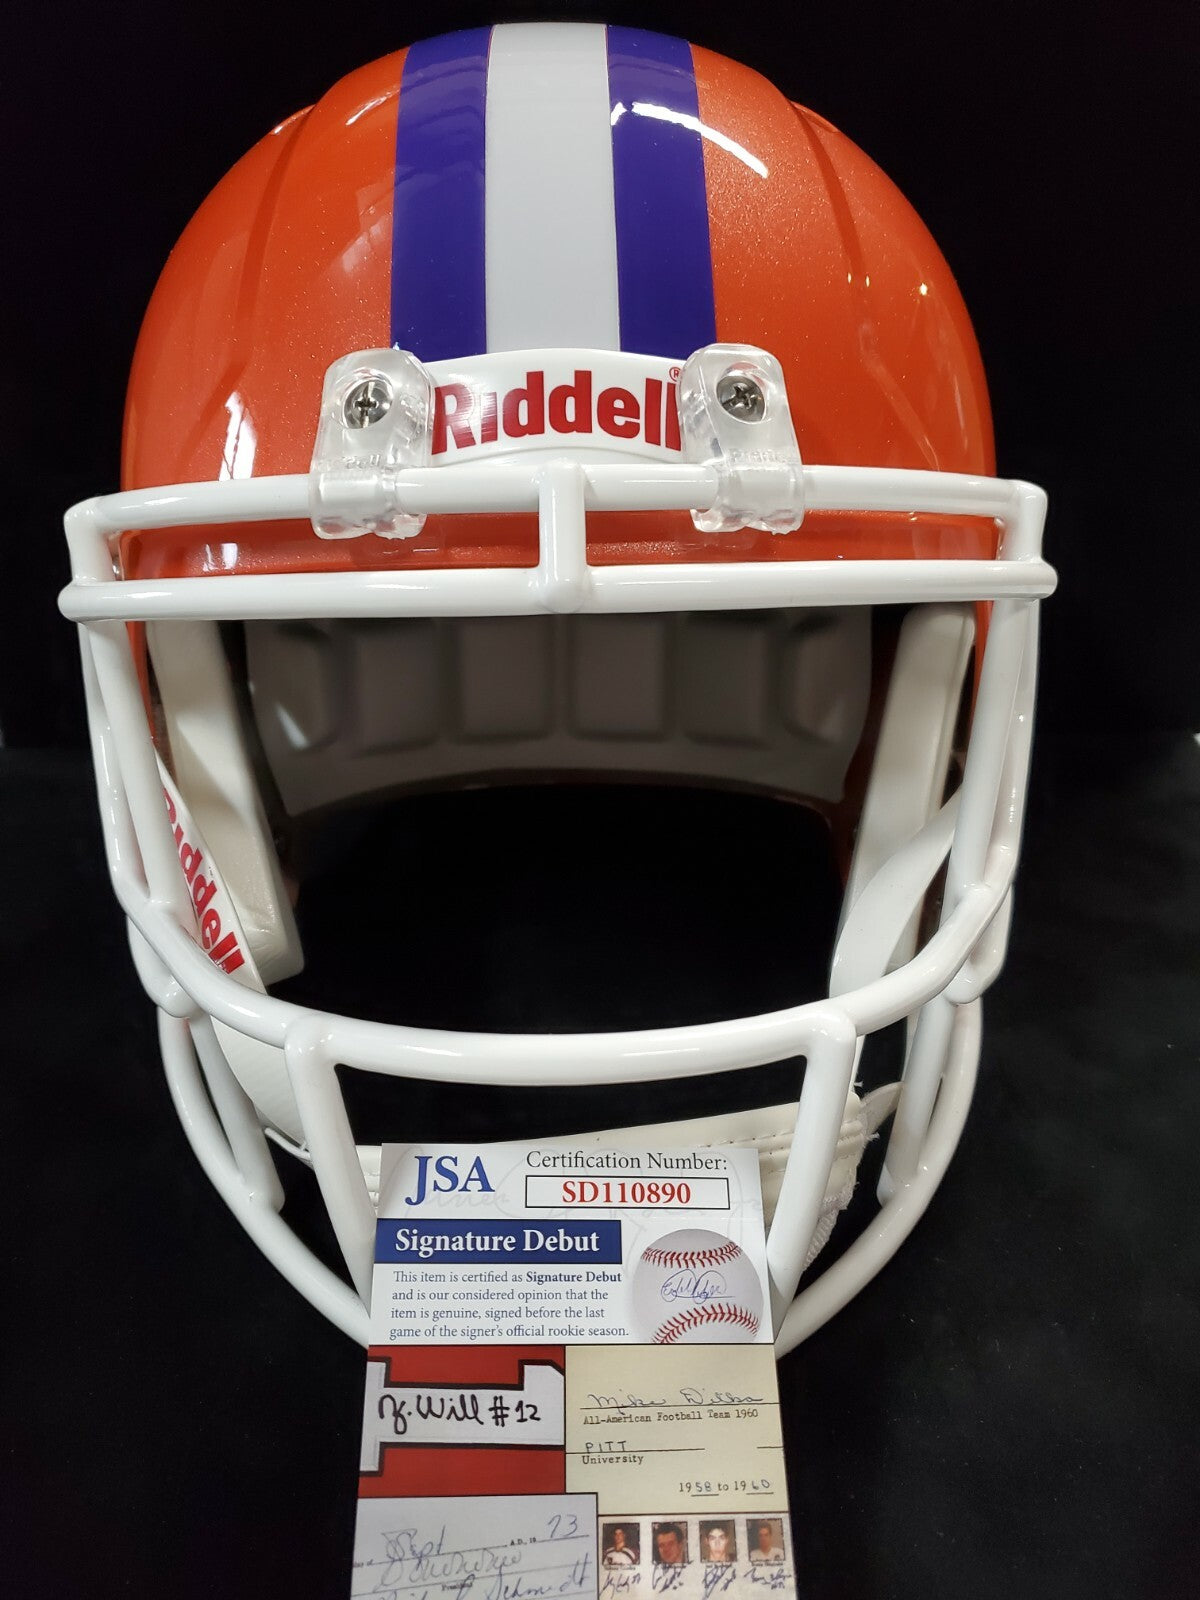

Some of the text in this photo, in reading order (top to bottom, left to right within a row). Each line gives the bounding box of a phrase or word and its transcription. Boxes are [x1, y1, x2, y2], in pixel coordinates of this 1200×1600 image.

[431, 369, 682, 455] Riddell
[526, 1150, 728, 1171] Certification Number:
[404, 1155, 496, 1206] JSA
[561, 1181, 691, 1204] SD110890
[395, 1228, 600, 1258] Signature Debut
[393, 1270, 622, 1287] This item is certified as Signature Debut
[392, 1289, 609, 1303] and is our considered opinion that the
[391, 1306, 605, 1322] item is genuine, signed before the last
[389, 1324, 629, 1341] game of the signer's official rookie season.
[416, 1394, 484, 1426] Will
[583, 1409, 759, 1425] All-American Football Team 1960
[585, 1441, 627, 1454] PITT
[581, 1454, 644, 1465] University
[717, 1482, 729, 1491] to
